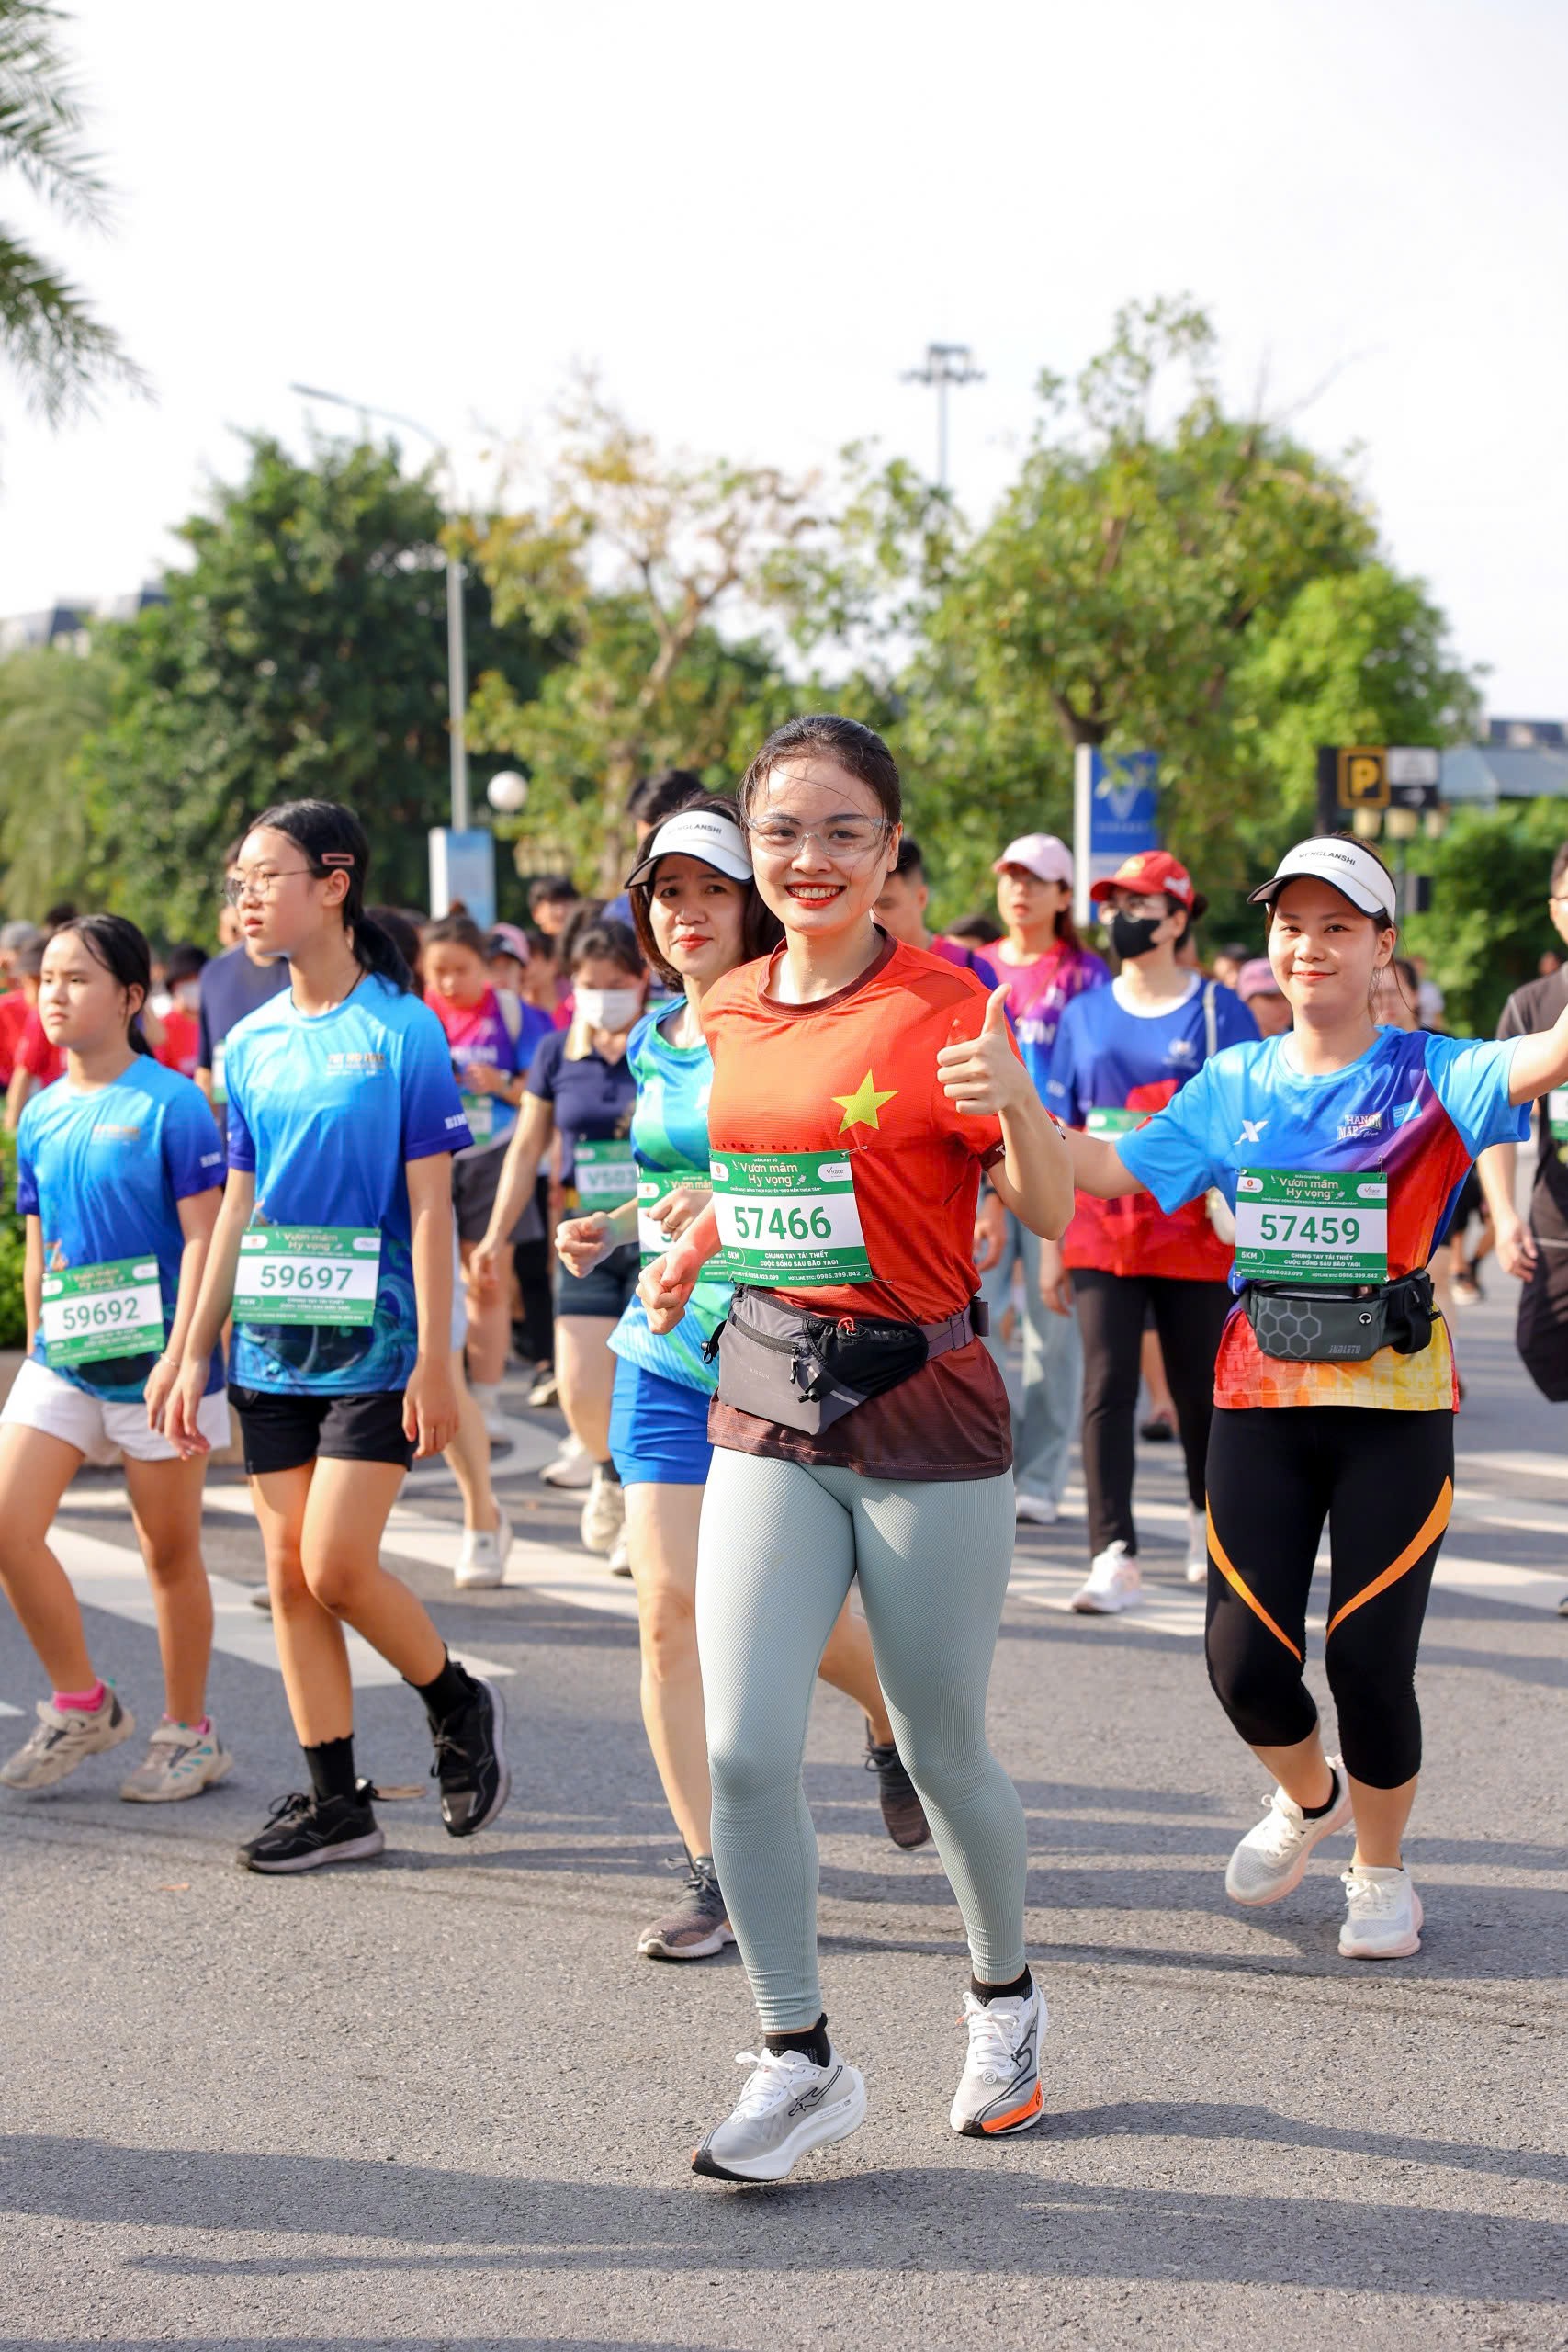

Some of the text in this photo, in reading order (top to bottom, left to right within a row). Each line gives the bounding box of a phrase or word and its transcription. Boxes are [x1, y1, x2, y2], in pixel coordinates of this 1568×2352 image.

[1350, 758, 1379, 797] P
[748, 1174, 792, 1187] Hy vọng
[1286, 1187, 1331, 1201] Hy vọng
[734, 1206, 832, 1240] 57466
[1259, 1213, 1360, 1245] 57459
[1241, 1251, 1257, 1260] 5KM
[1283, 1259, 1301, 1267] CUỘC
[1302, 1259, 1318, 1267] SỐNG
[260, 1264, 354, 1291] 59697
[62, 1296, 141, 1330] 59692
